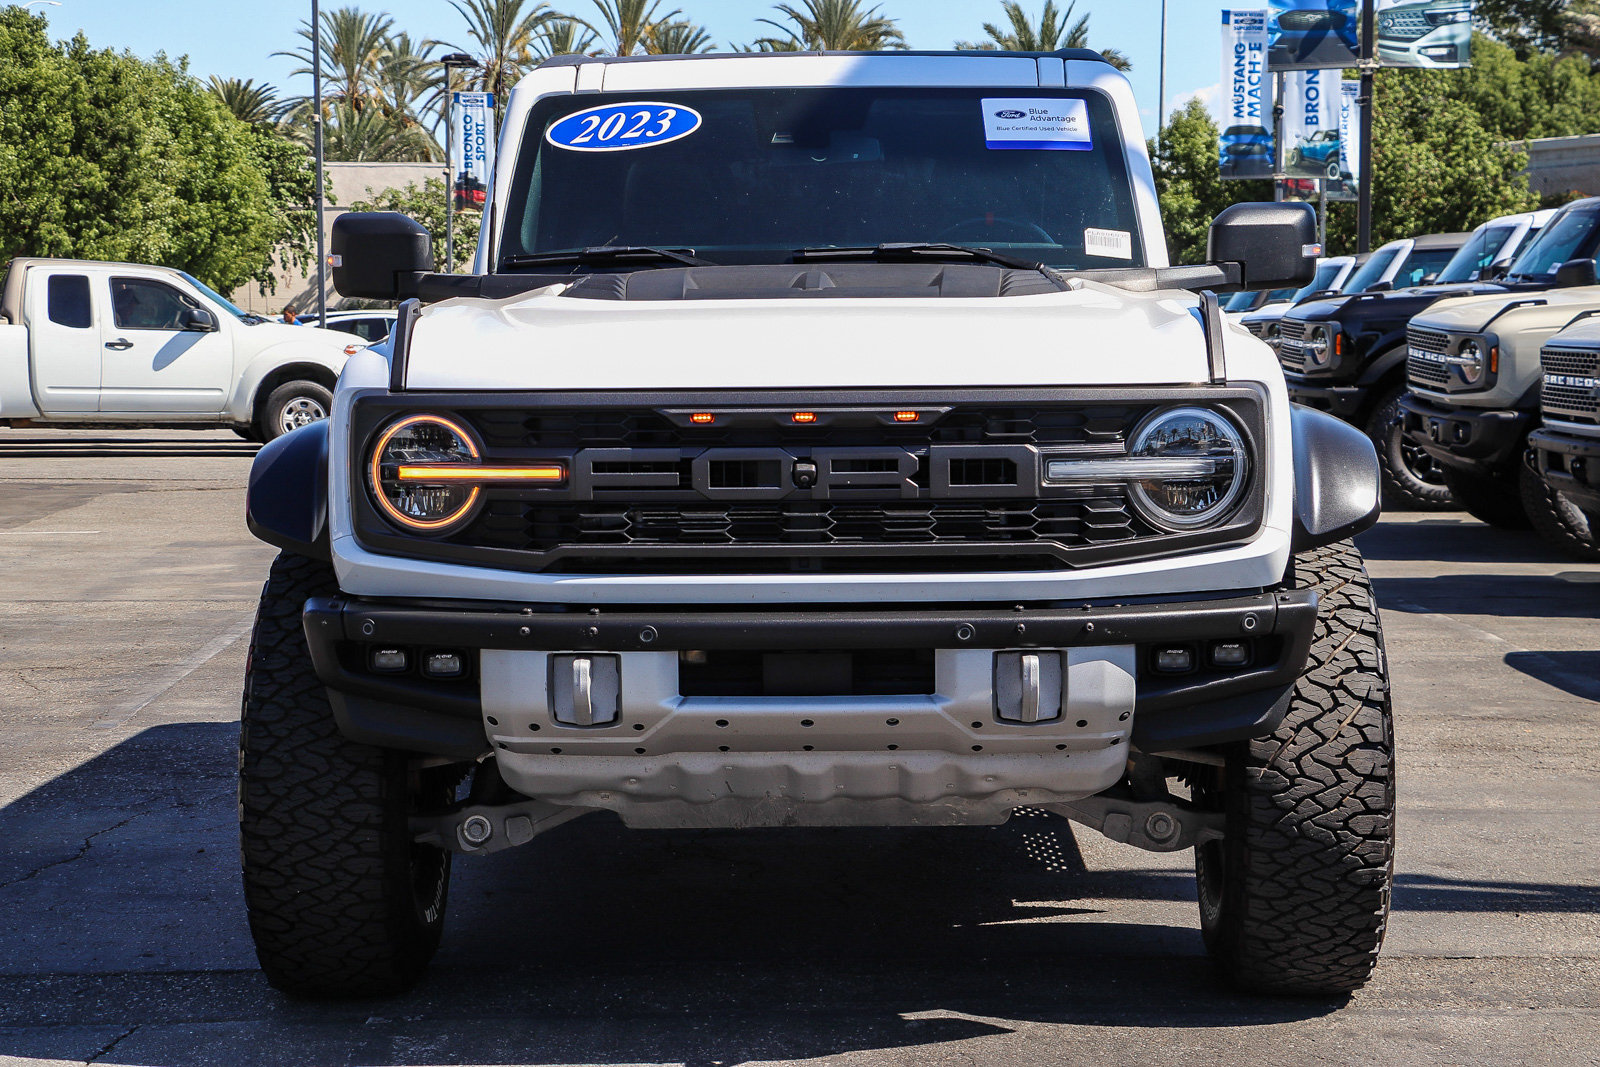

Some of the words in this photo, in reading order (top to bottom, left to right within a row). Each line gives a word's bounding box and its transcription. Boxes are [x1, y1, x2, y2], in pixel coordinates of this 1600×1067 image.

[1233, 42, 1246, 119] MUSTANG
[1247, 42, 1262, 118] MACH-E
[463, 113, 473, 169] BRONCO
[475, 121, 486, 161] SPORT
[569, 108, 677, 145] 2023
[1030, 115, 1077, 123] Advantage
[1340, 103, 1350, 162] MAVERICK
[1543, 374, 1594, 387] BRONCO
[573, 445, 1040, 499] FORD
